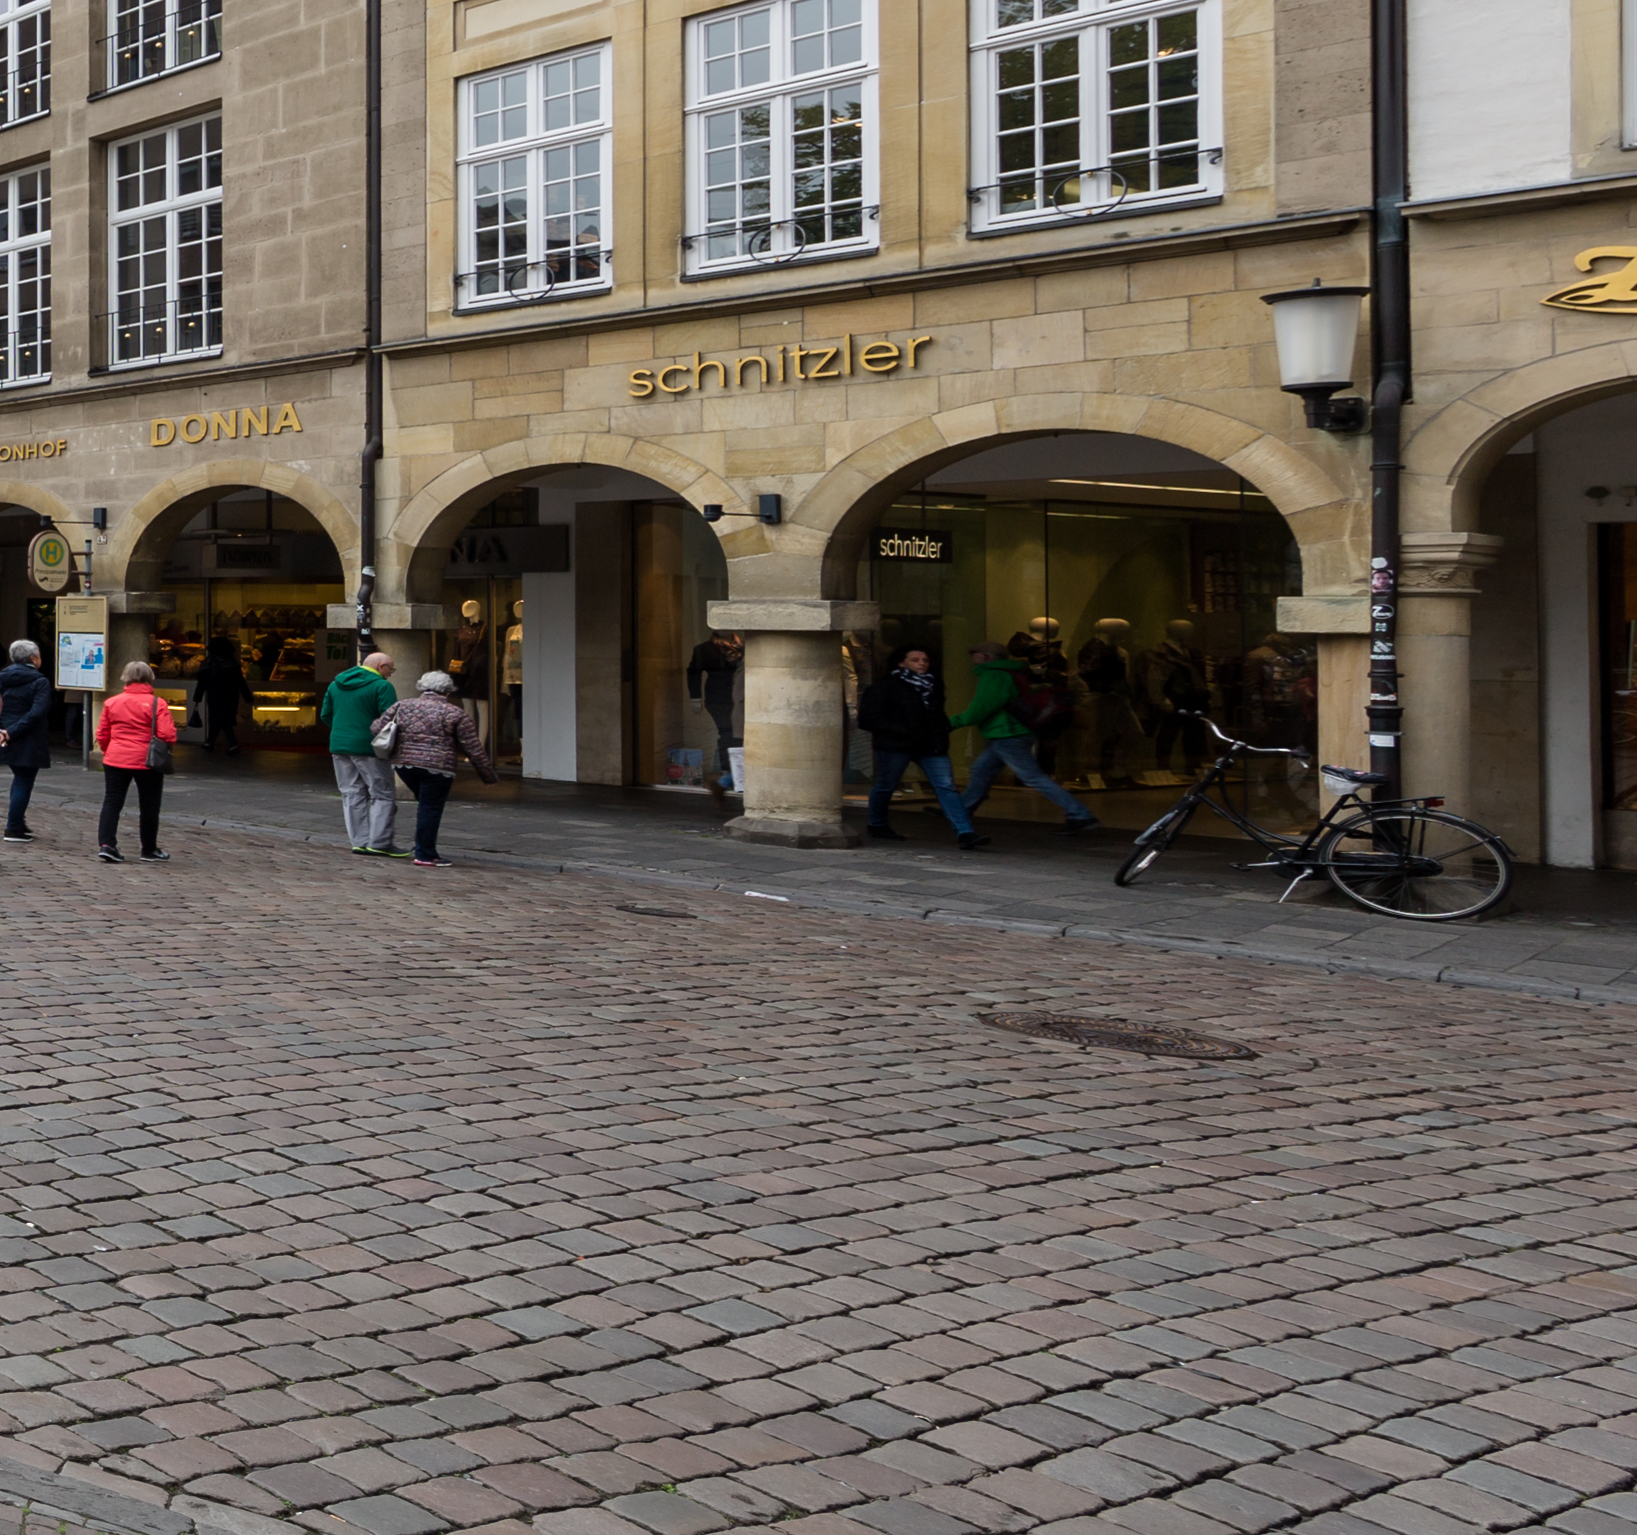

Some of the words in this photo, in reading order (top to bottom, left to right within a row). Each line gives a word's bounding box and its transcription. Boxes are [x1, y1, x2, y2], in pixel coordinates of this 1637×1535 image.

[629, 333, 932, 397] schnitzler
[150, 402, 304, 448] DONNA
[880, 533, 943, 559] schnitzler
